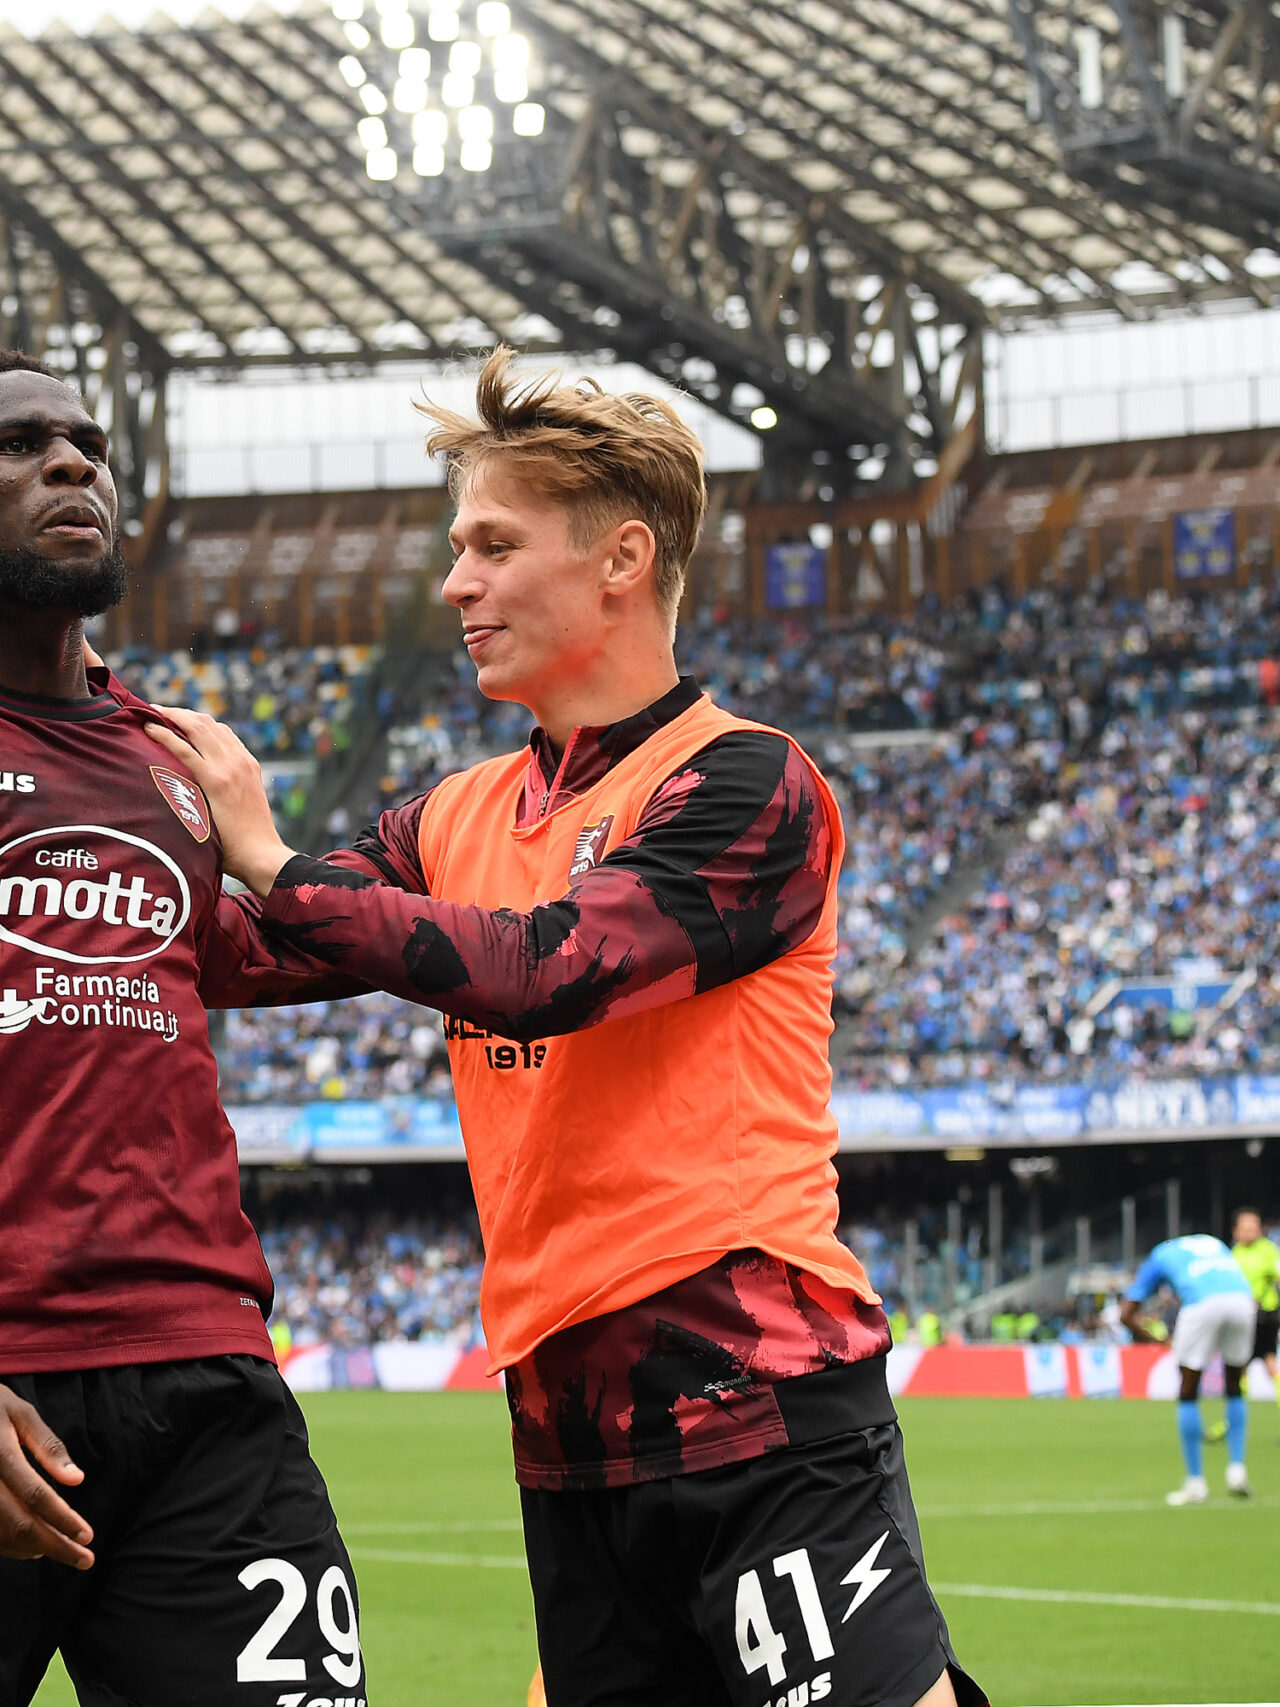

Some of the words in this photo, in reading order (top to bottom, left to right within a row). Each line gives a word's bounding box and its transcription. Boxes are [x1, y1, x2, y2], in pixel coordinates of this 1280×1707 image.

[35, 967, 160, 1004] Farmacia
[485, 1045, 547, 1069] 1919
[236, 1558, 362, 1688] 29
[735, 1548, 836, 1687] 41
